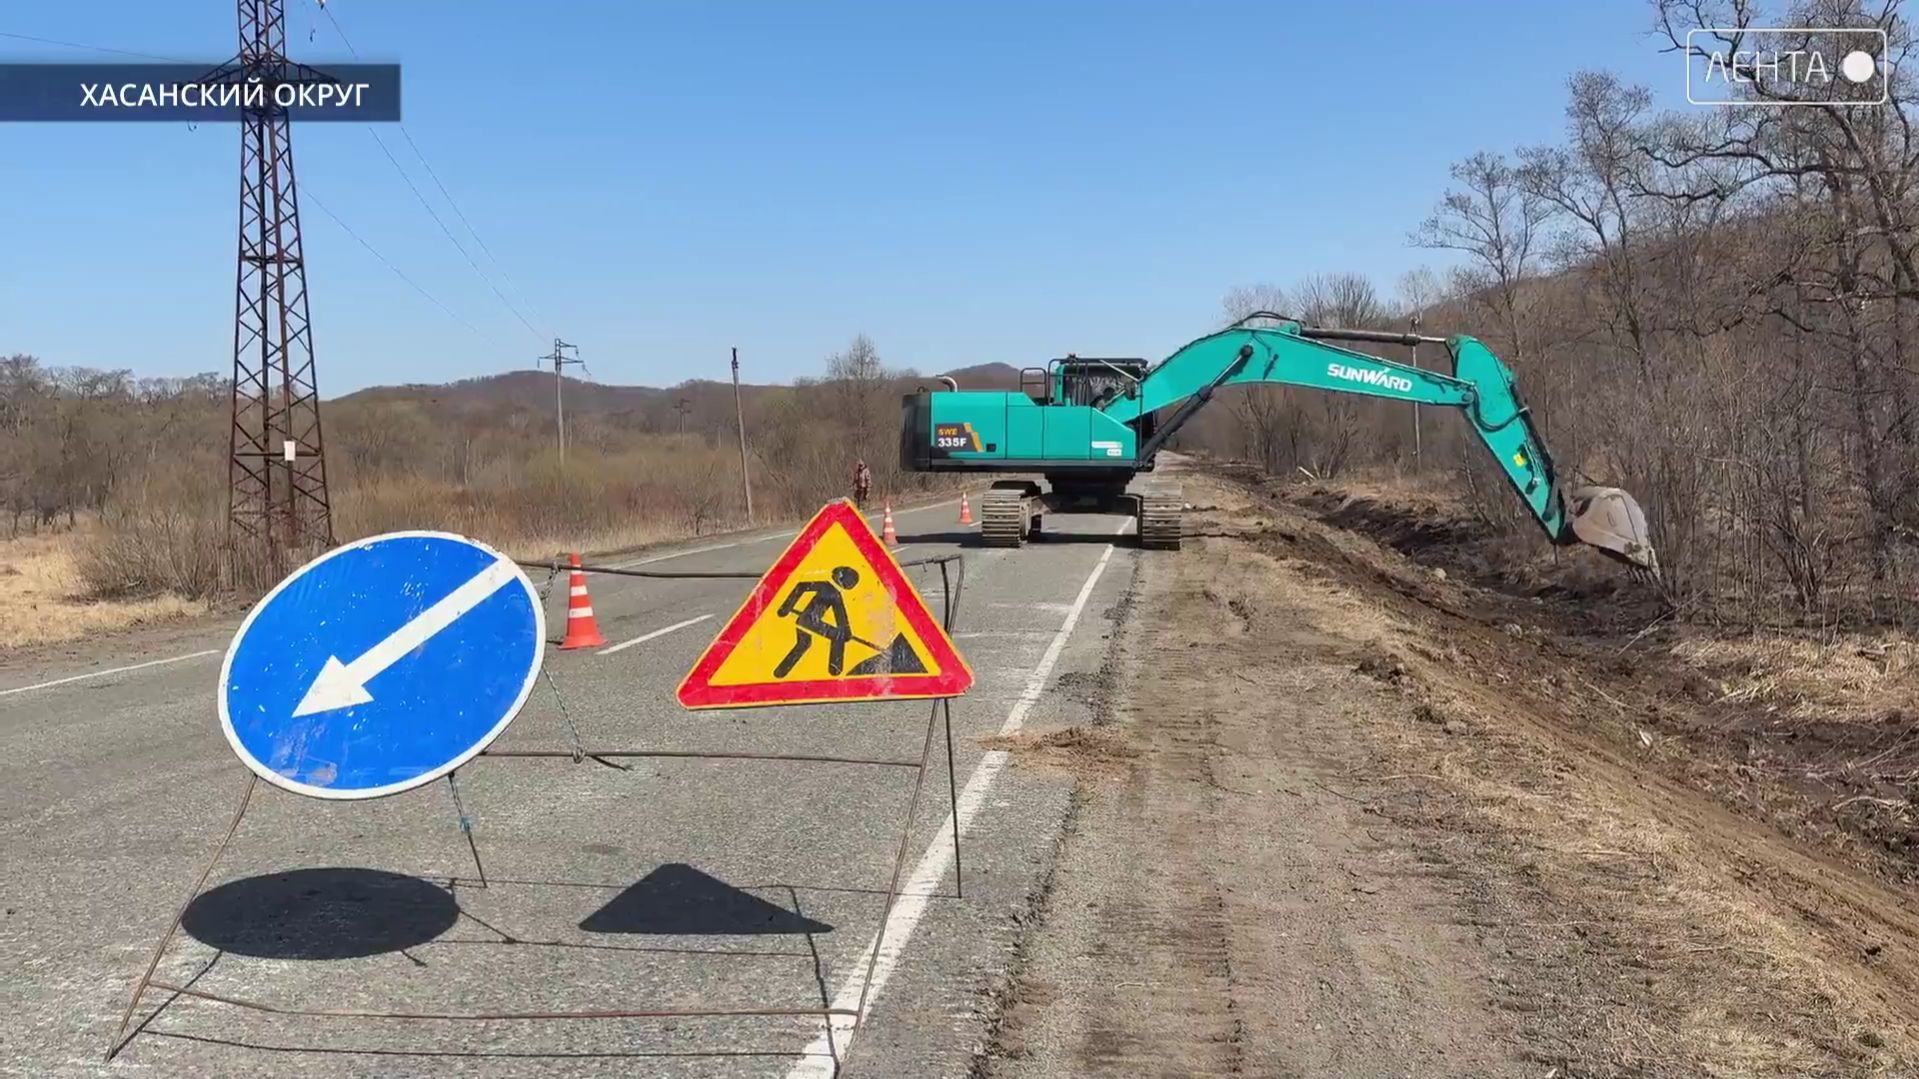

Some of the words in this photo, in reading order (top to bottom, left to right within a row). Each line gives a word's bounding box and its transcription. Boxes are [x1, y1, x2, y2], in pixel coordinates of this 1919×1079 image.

[1327, 363, 1413, 392] SUNWARD
[938, 427, 958, 436] SWE
[938, 437, 967, 448] 335F
